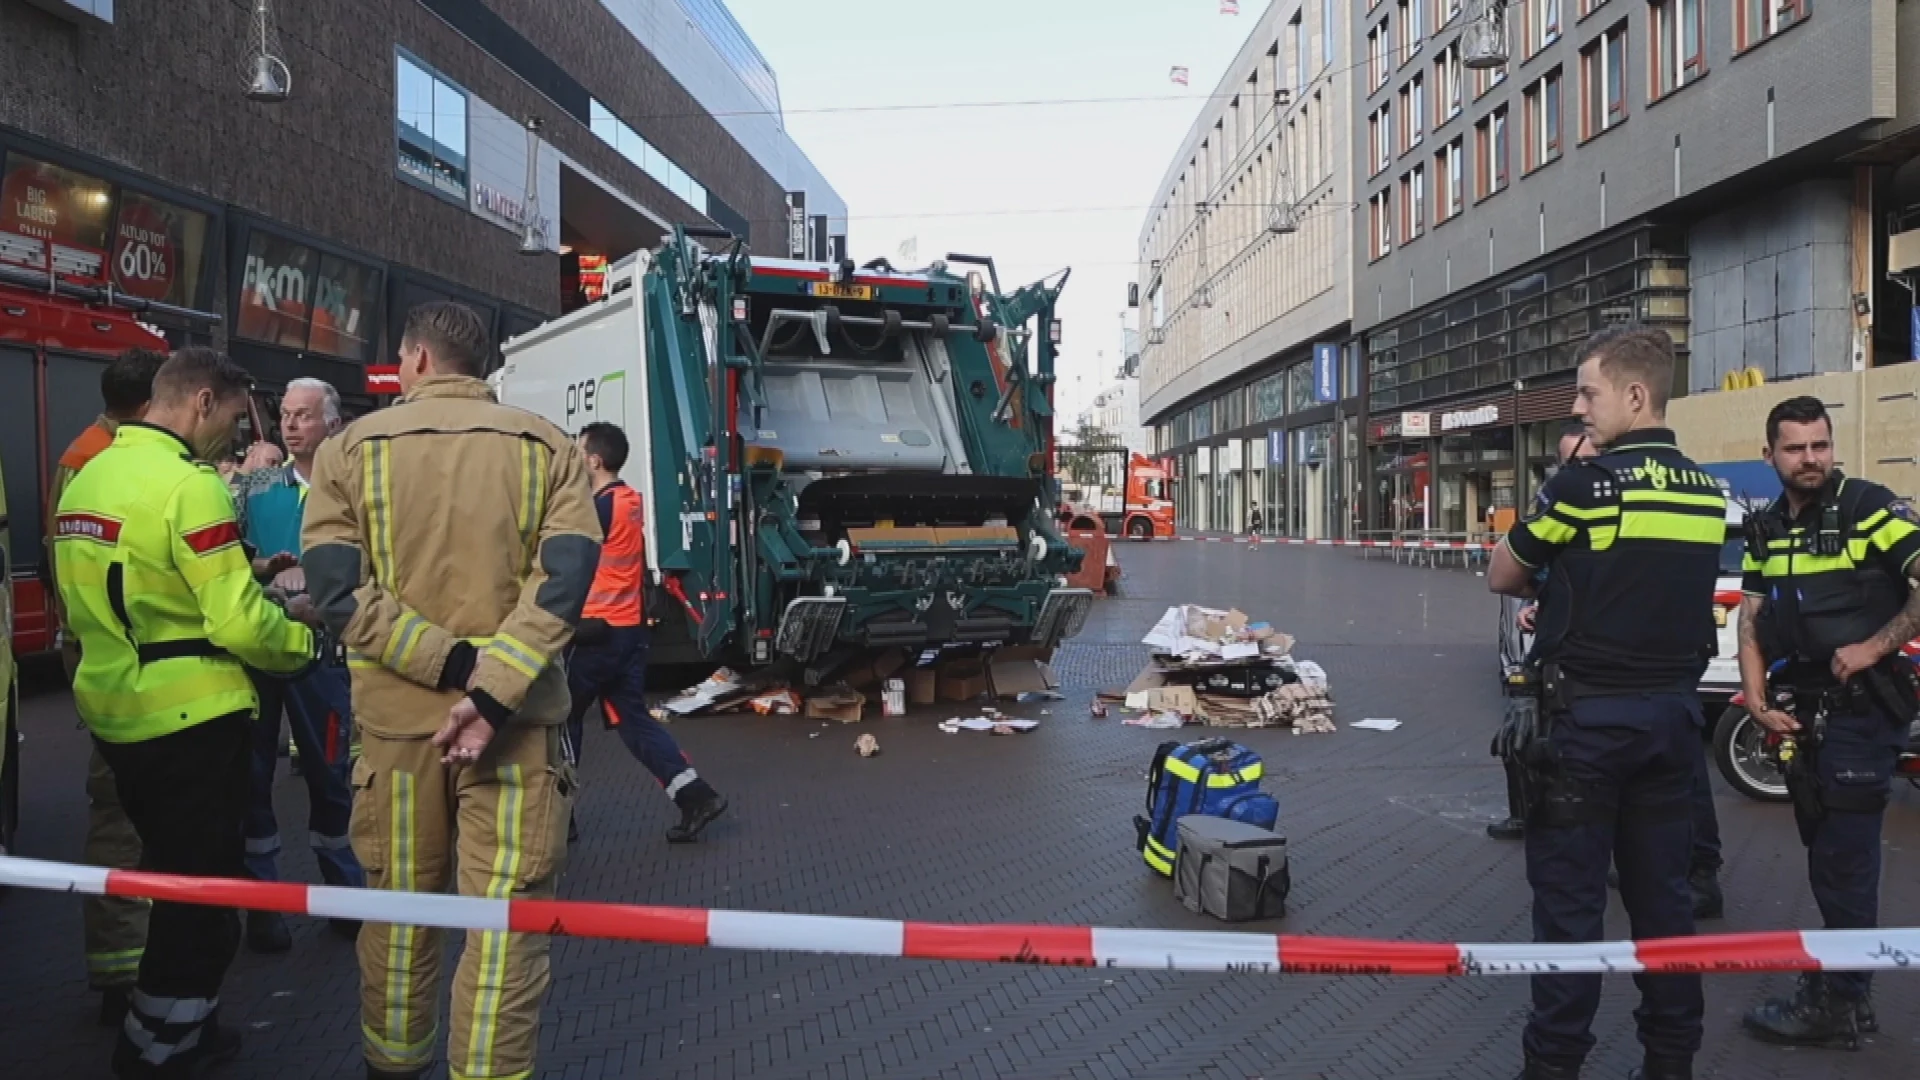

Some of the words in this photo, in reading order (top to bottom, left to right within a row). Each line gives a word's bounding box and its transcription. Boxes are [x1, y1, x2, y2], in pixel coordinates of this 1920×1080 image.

[27, 186, 46, 204] BIG
[16, 201, 58, 225] LABELS
[120, 224, 148, 243] ALTIJD
[150, 231, 166, 248] TOT
[120, 241, 166, 280] 60%
[566, 378, 596, 427] pre
[1633, 456, 1718, 490] POLITIE
